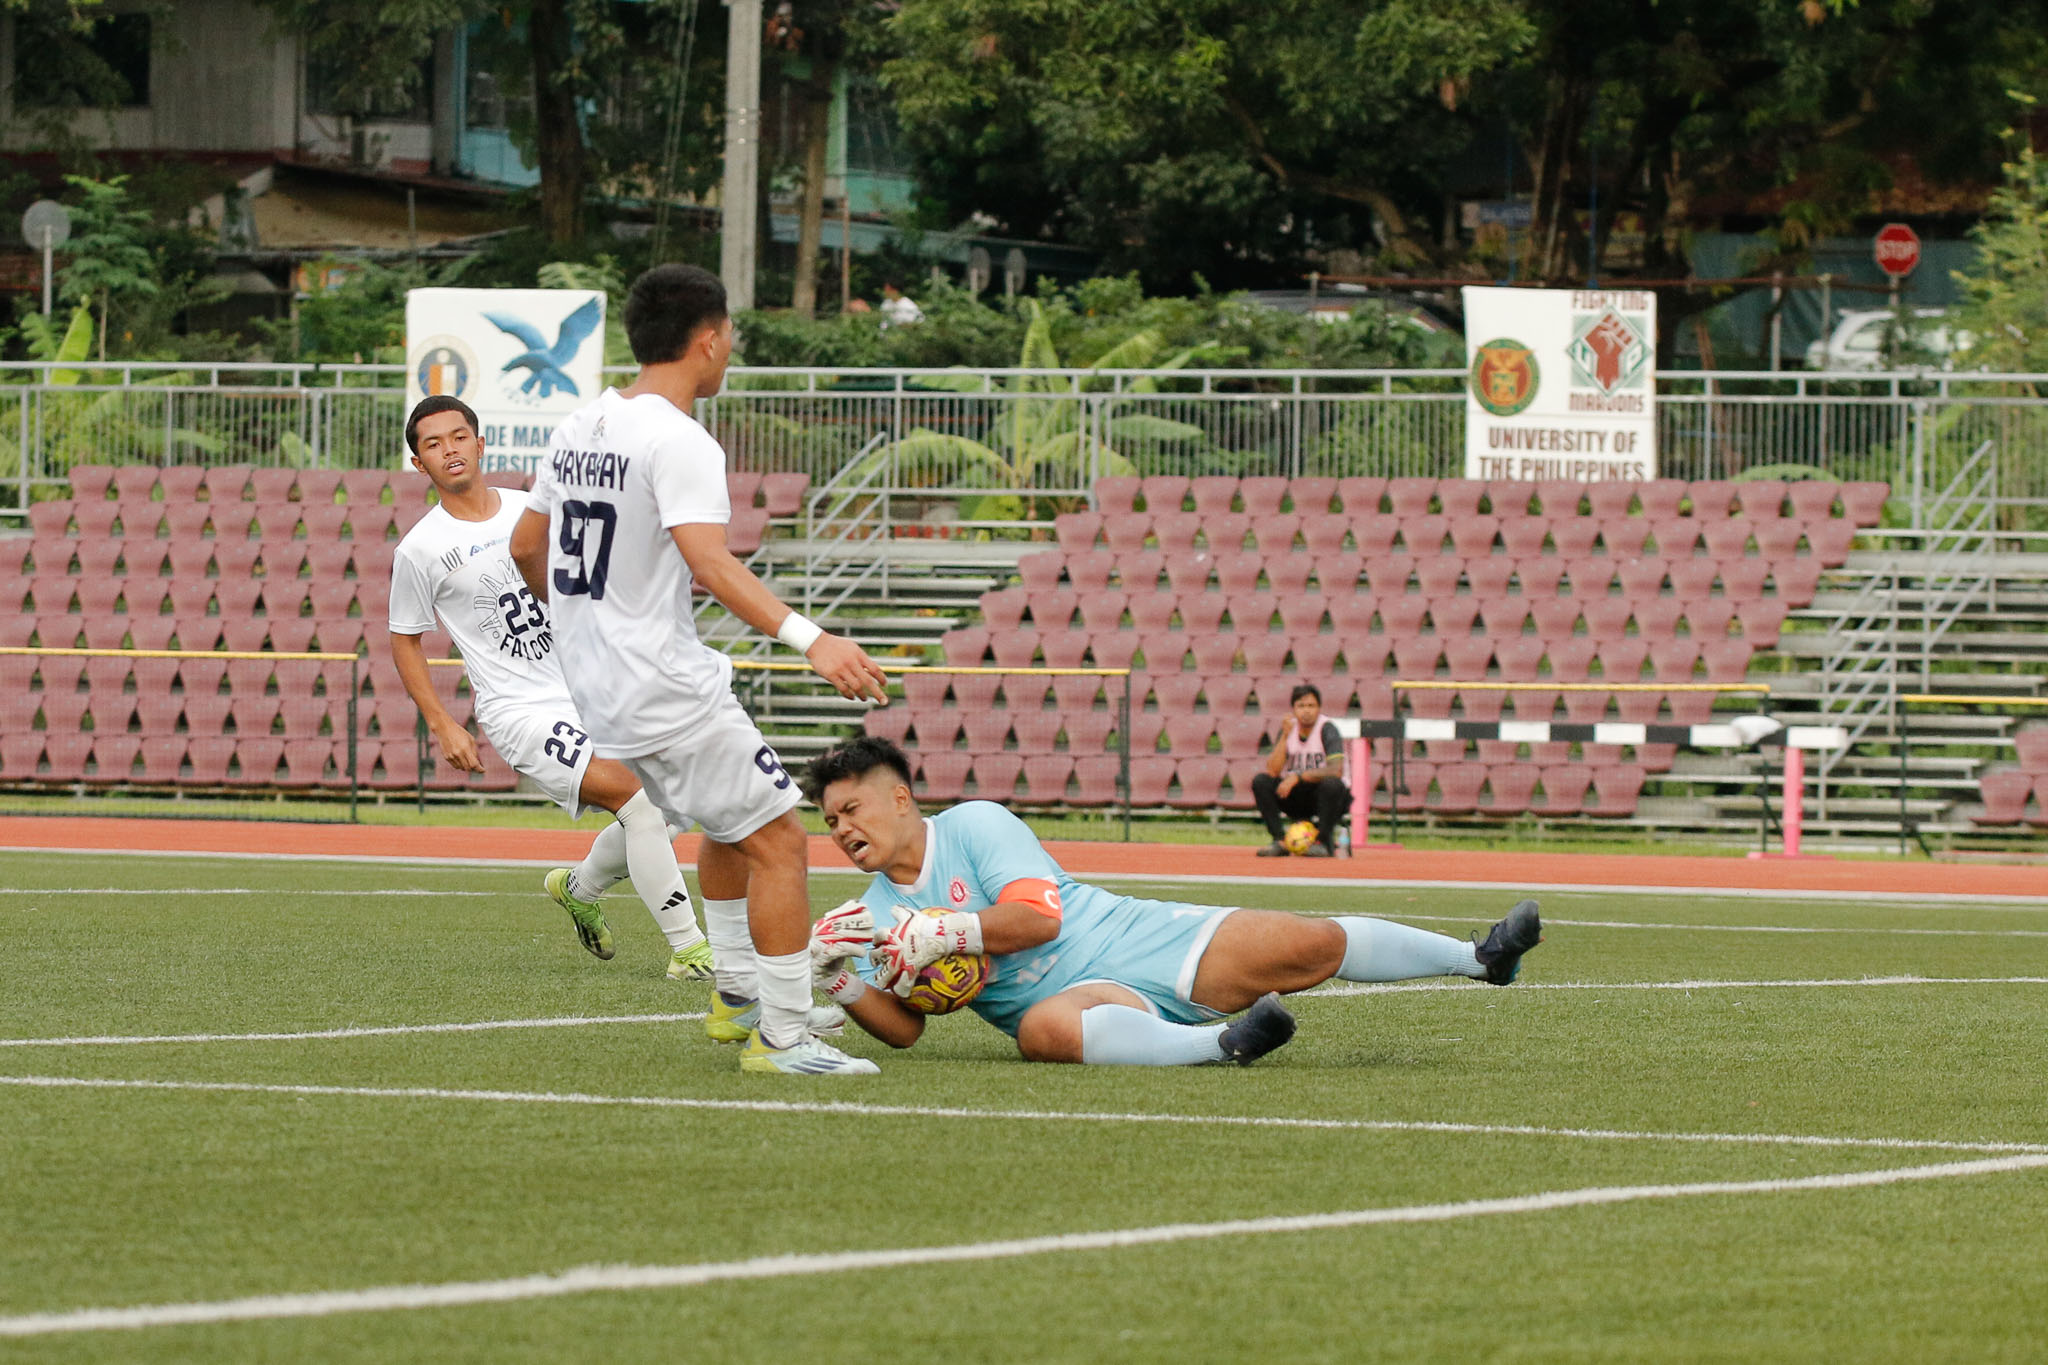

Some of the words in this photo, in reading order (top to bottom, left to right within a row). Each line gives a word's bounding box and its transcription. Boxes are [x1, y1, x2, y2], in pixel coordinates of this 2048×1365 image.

[1880, 240, 1917, 260] STOP
[485, 425, 506, 447] DE
[1488, 426, 1607, 452] UNIVERSITY
[1614, 431, 1637, 453] OF
[1480, 456, 1514, 480] THE
[1520, 458, 1645, 482] PHILIPPINES
[554, 500, 617, 600] 97
[499, 587, 545, 636] 23
[545, 721, 588, 768] 23
[1044, 889, 1060, 910] C
